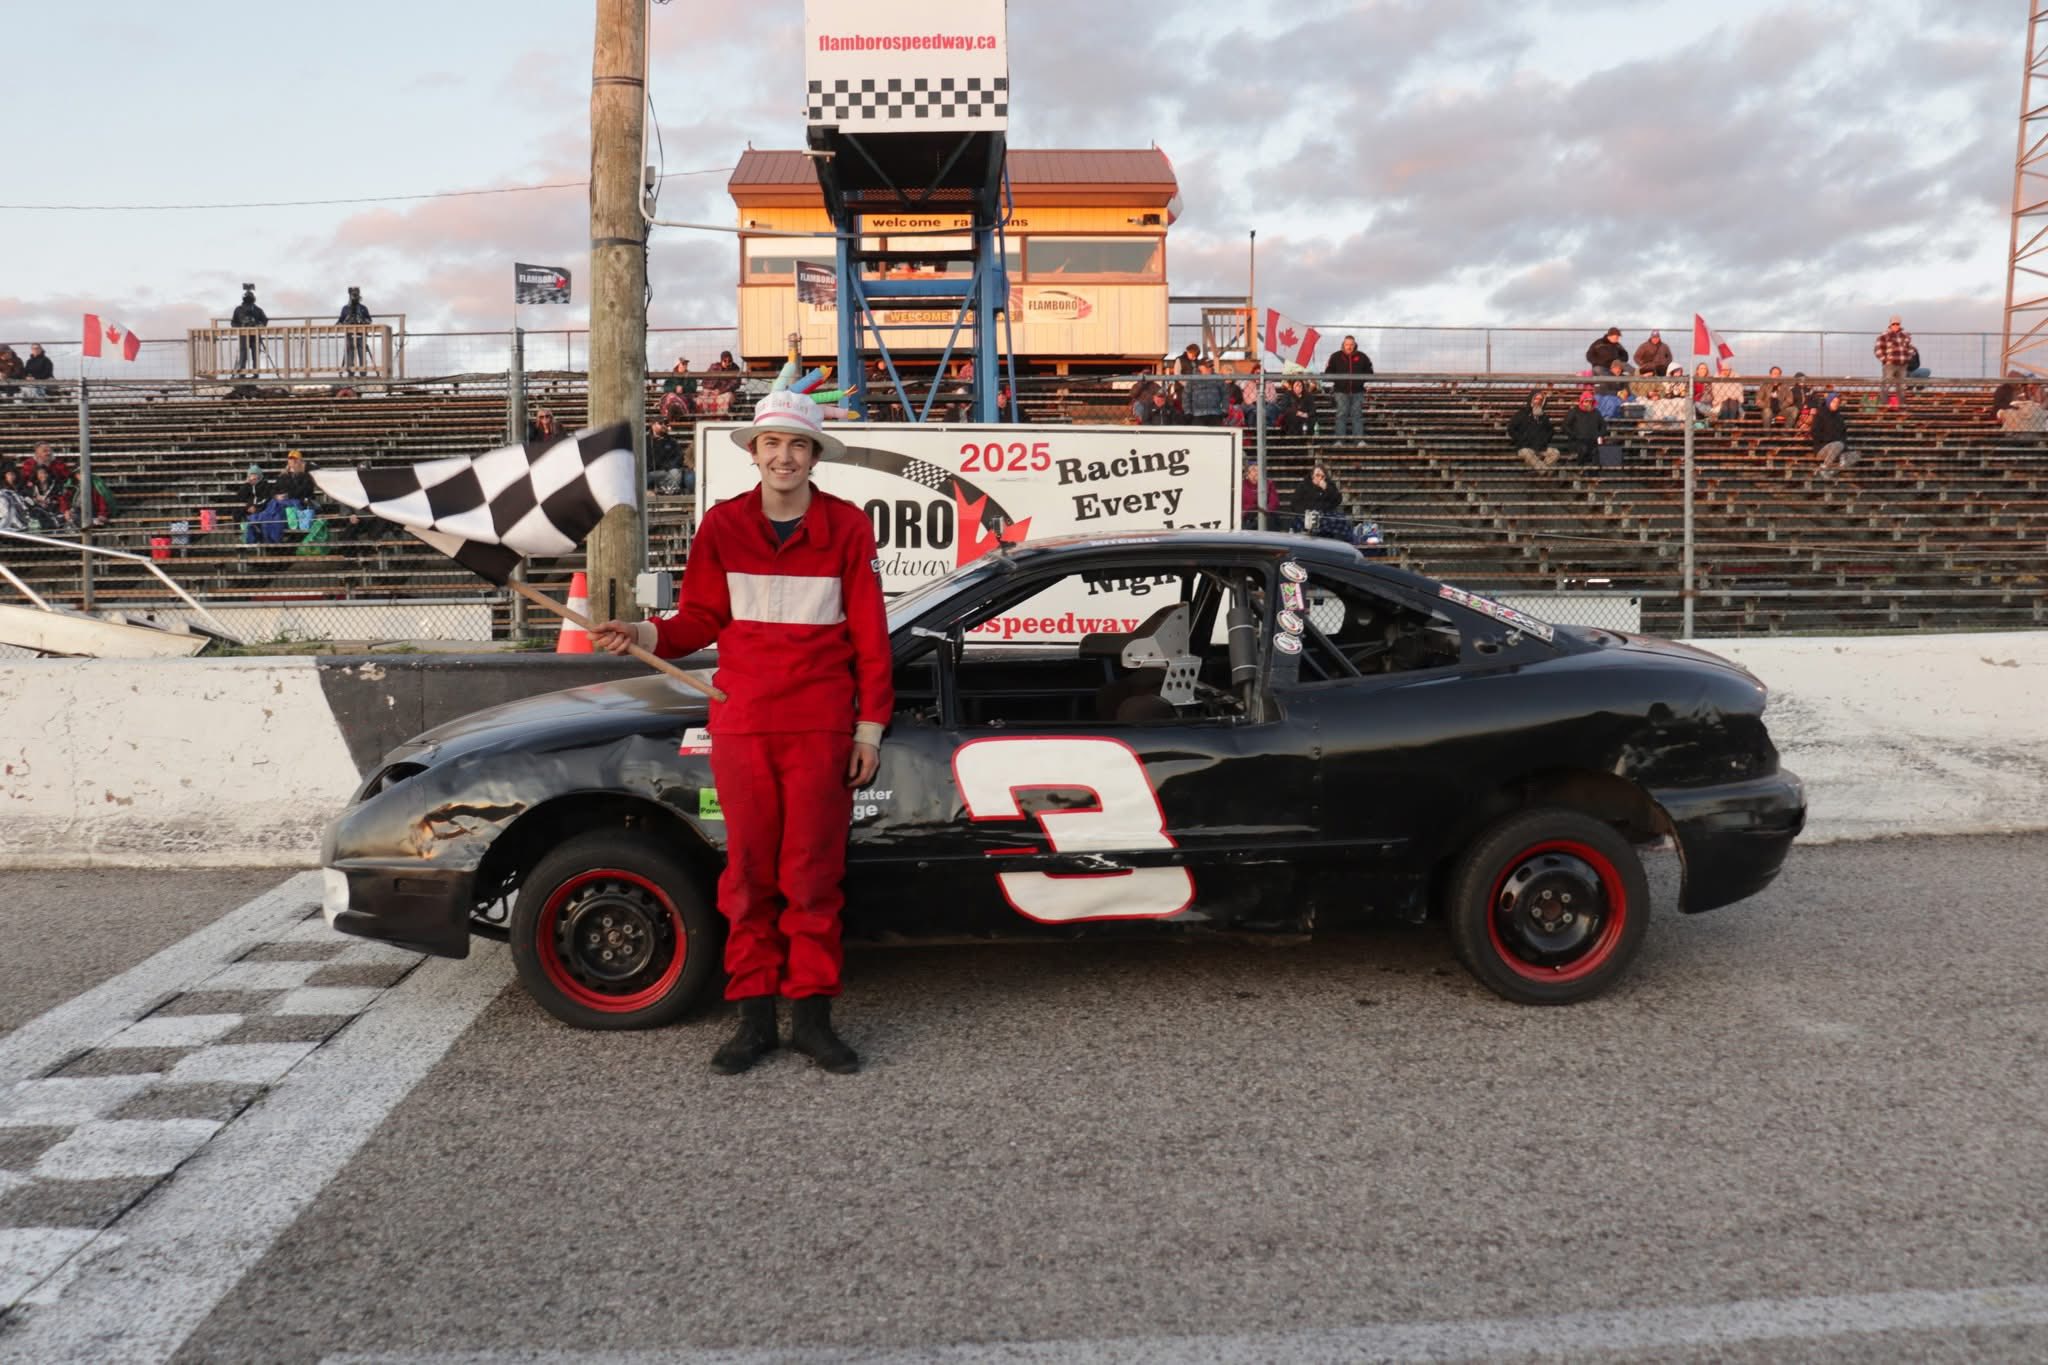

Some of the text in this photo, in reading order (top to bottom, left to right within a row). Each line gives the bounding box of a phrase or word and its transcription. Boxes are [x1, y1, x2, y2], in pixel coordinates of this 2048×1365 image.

[819, 33, 996, 51] flamborospeedway.ca
[873, 217, 941, 227] welcome
[890, 312, 948, 321] WELCOME
[1029, 300, 1077, 311] FLAMBORO
[960, 443, 1051, 472] 2025
[1056, 449, 1190, 485] Racing
[1072, 488, 1183, 521] Every
[951, 735, 1197, 925] 3
